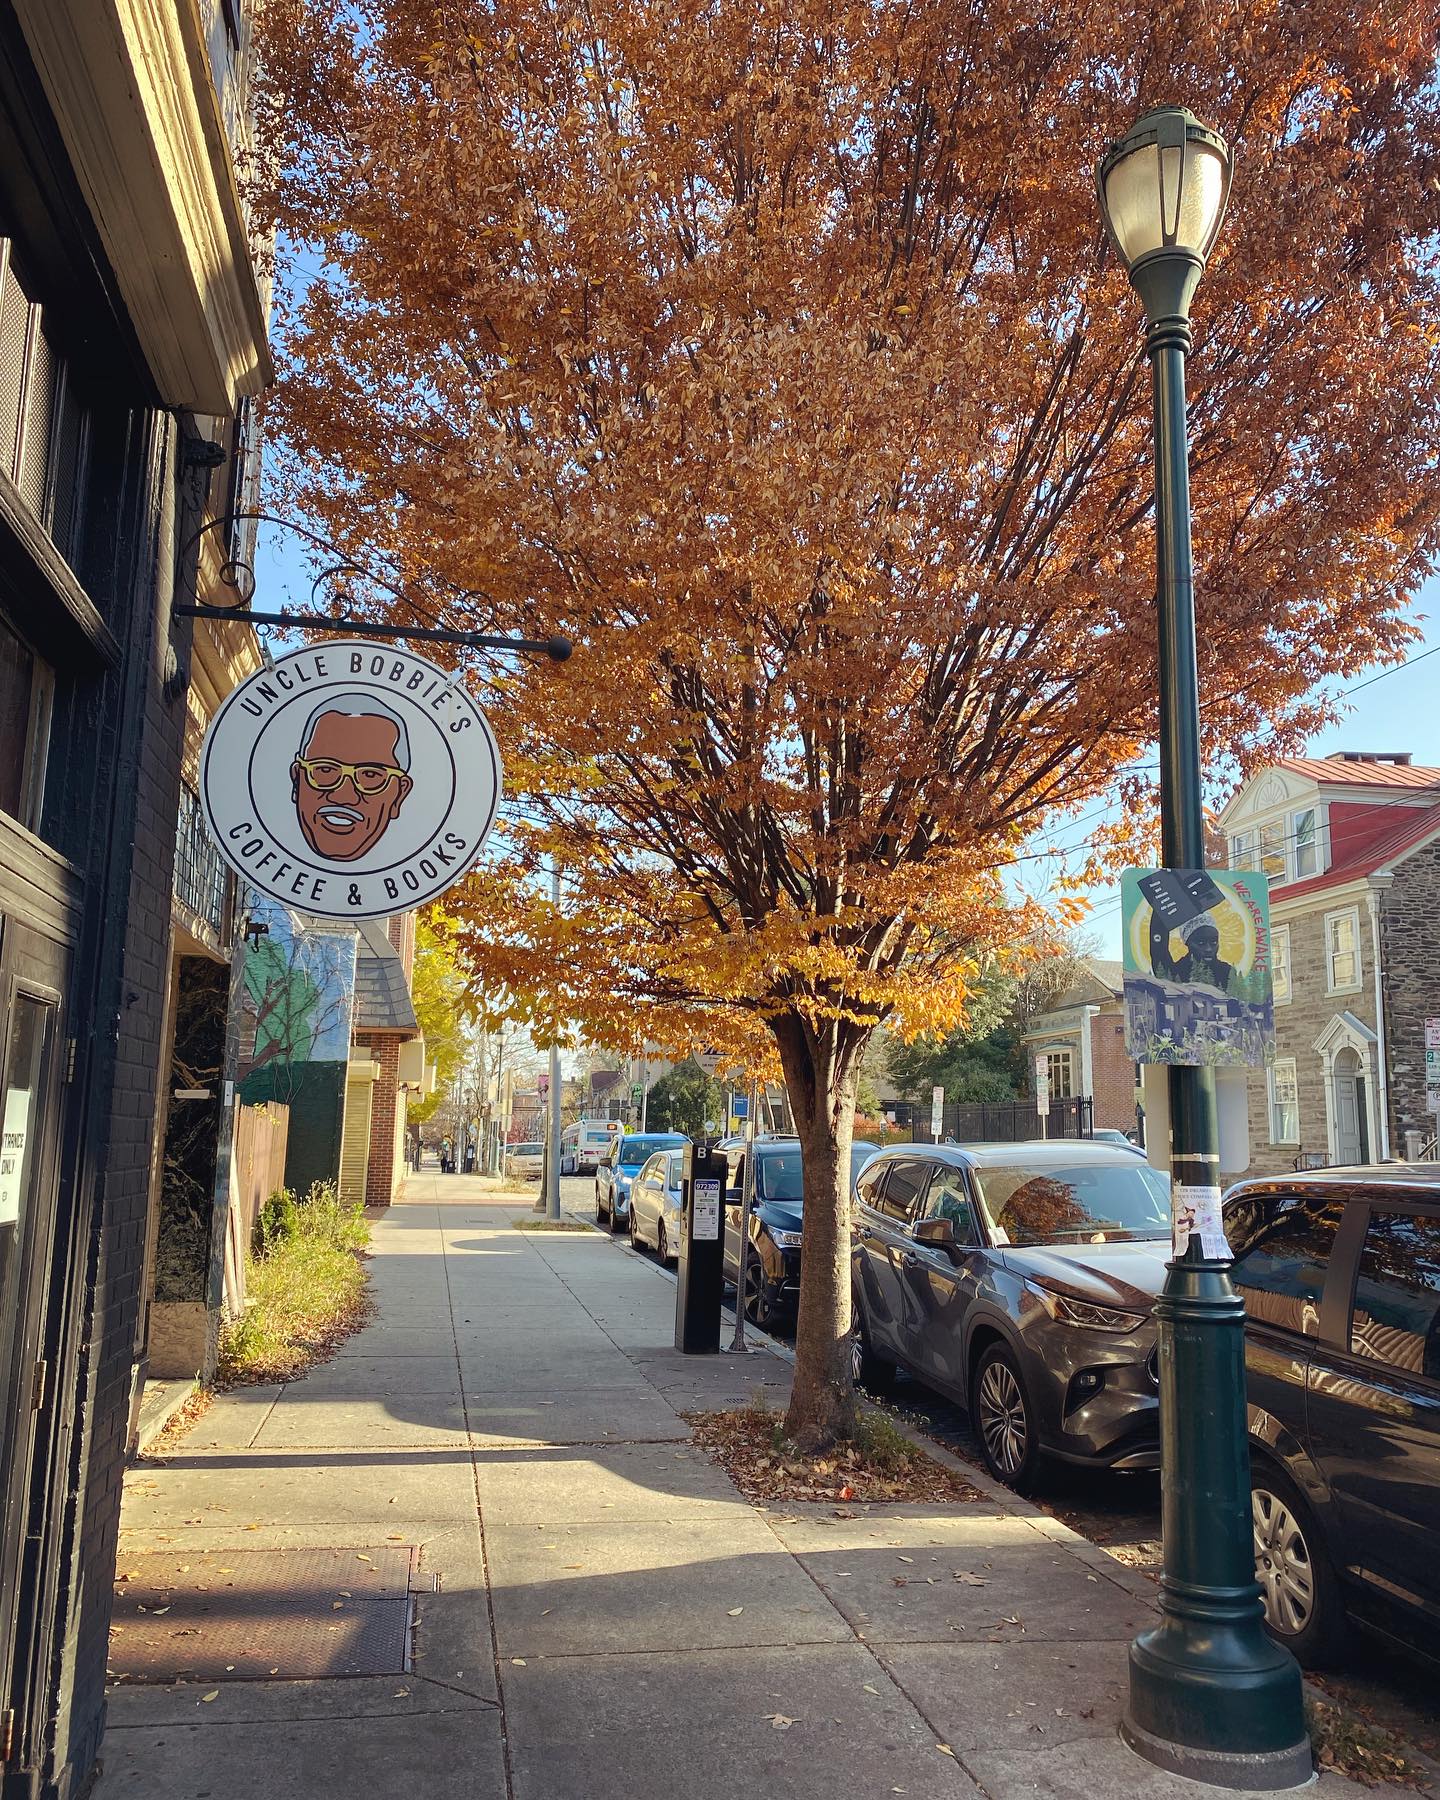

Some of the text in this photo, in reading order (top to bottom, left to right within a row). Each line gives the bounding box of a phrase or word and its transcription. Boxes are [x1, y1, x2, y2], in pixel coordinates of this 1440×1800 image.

[240, 652, 471, 733] UNCLE BOBBIE'S
[230, 822, 467, 906] COFFEE & BOOKS
[1231, 879, 1270, 972] WE ARE AWAKE
[4, 1133, 24, 1148] TRANCE
[697, 1147, 707, 1159] B
